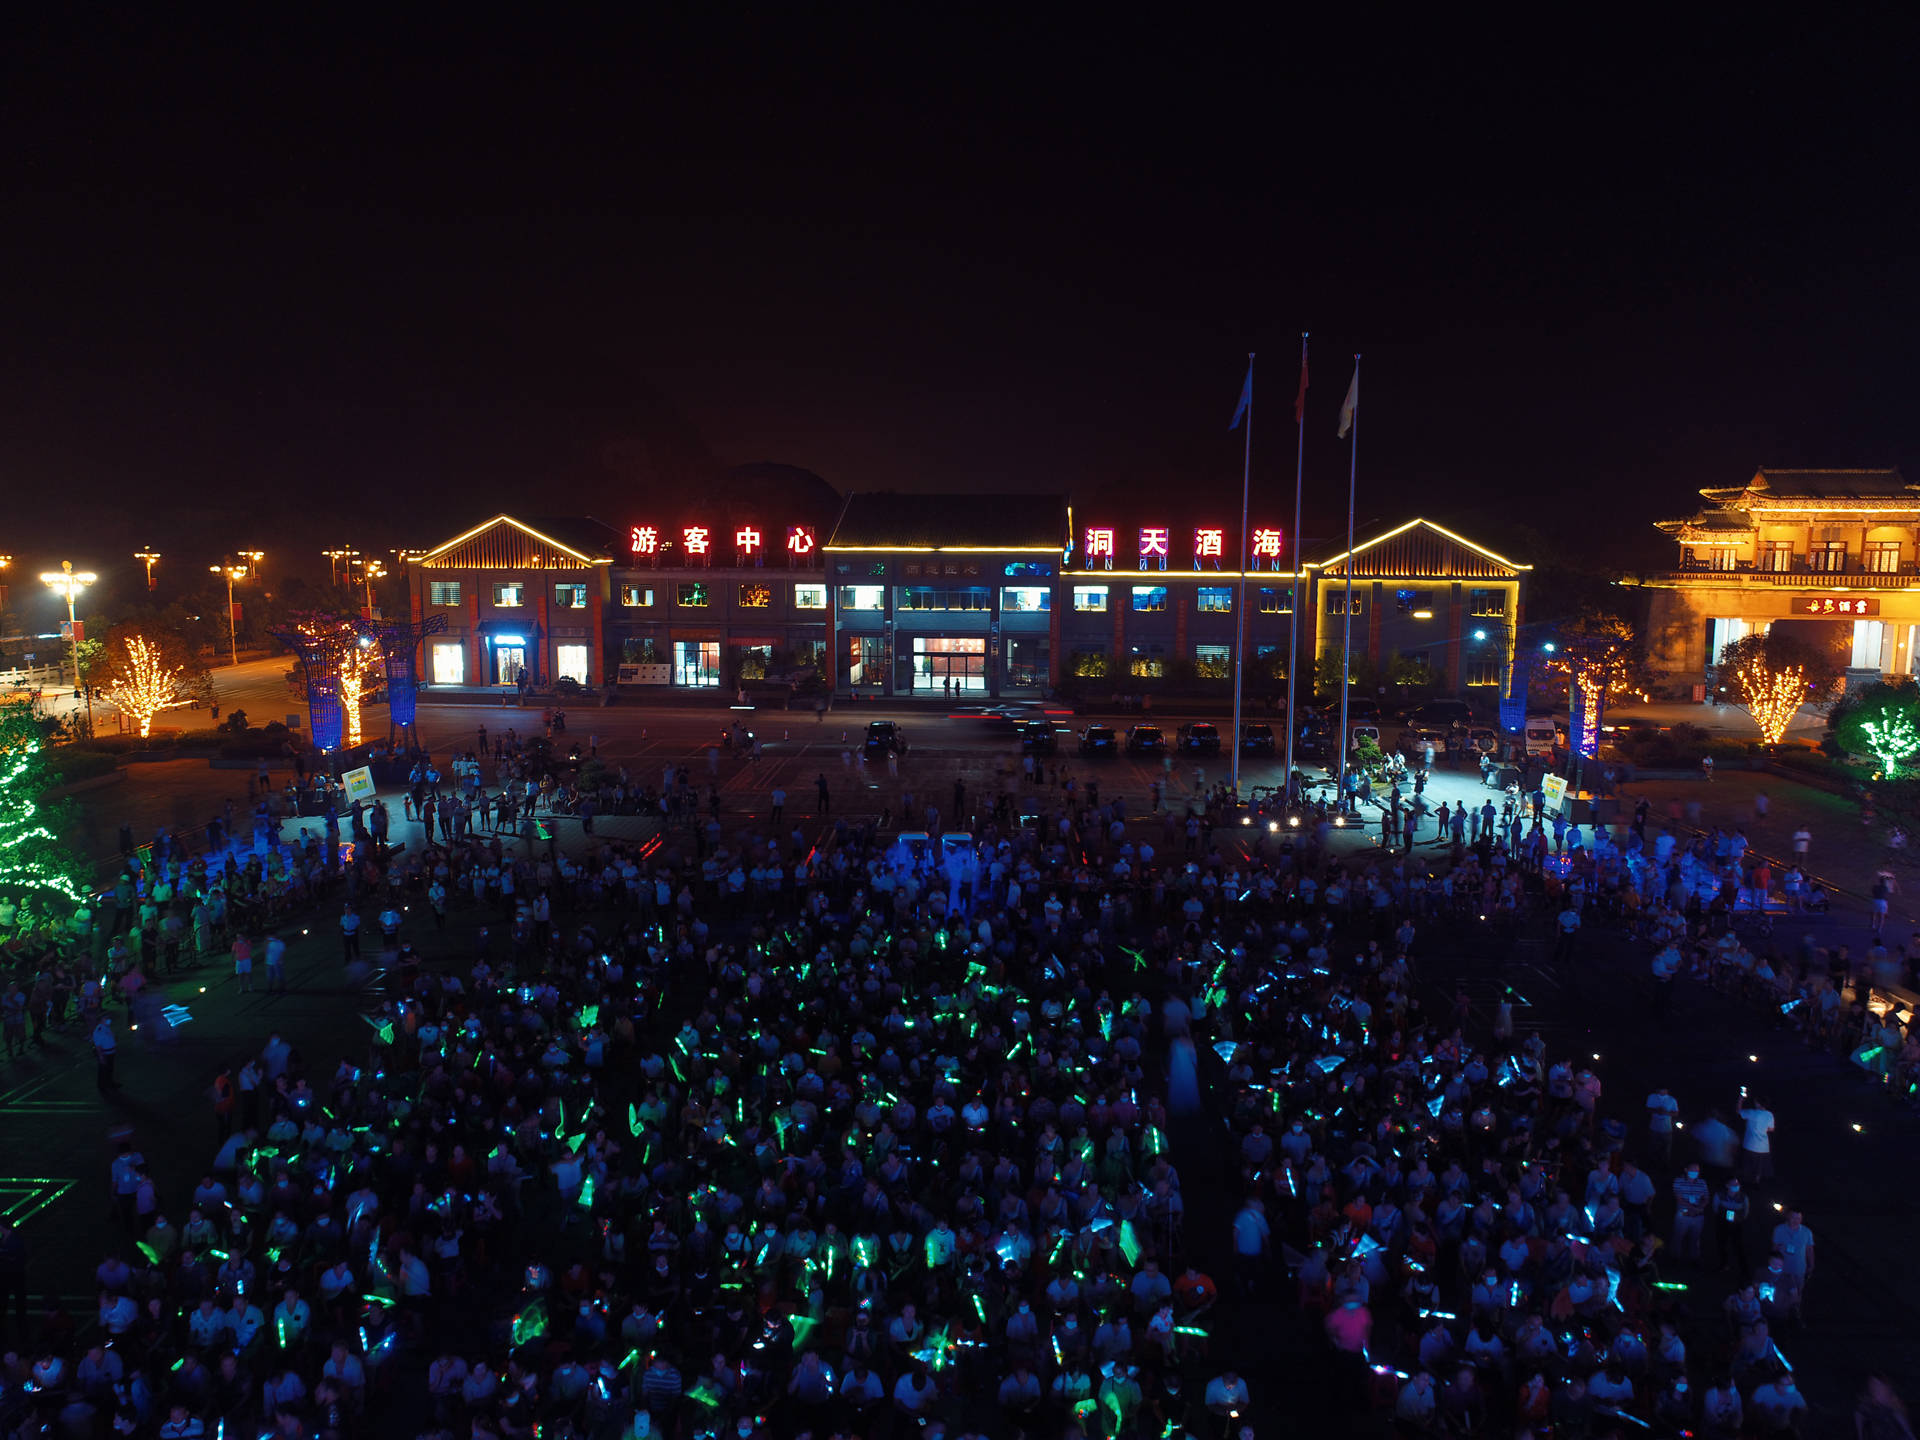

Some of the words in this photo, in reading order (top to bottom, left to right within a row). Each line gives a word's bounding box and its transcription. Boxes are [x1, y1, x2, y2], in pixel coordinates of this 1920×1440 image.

[631, 526, 814, 554] 游客中心
[1086, 528, 1281, 556] 洞天酒海
